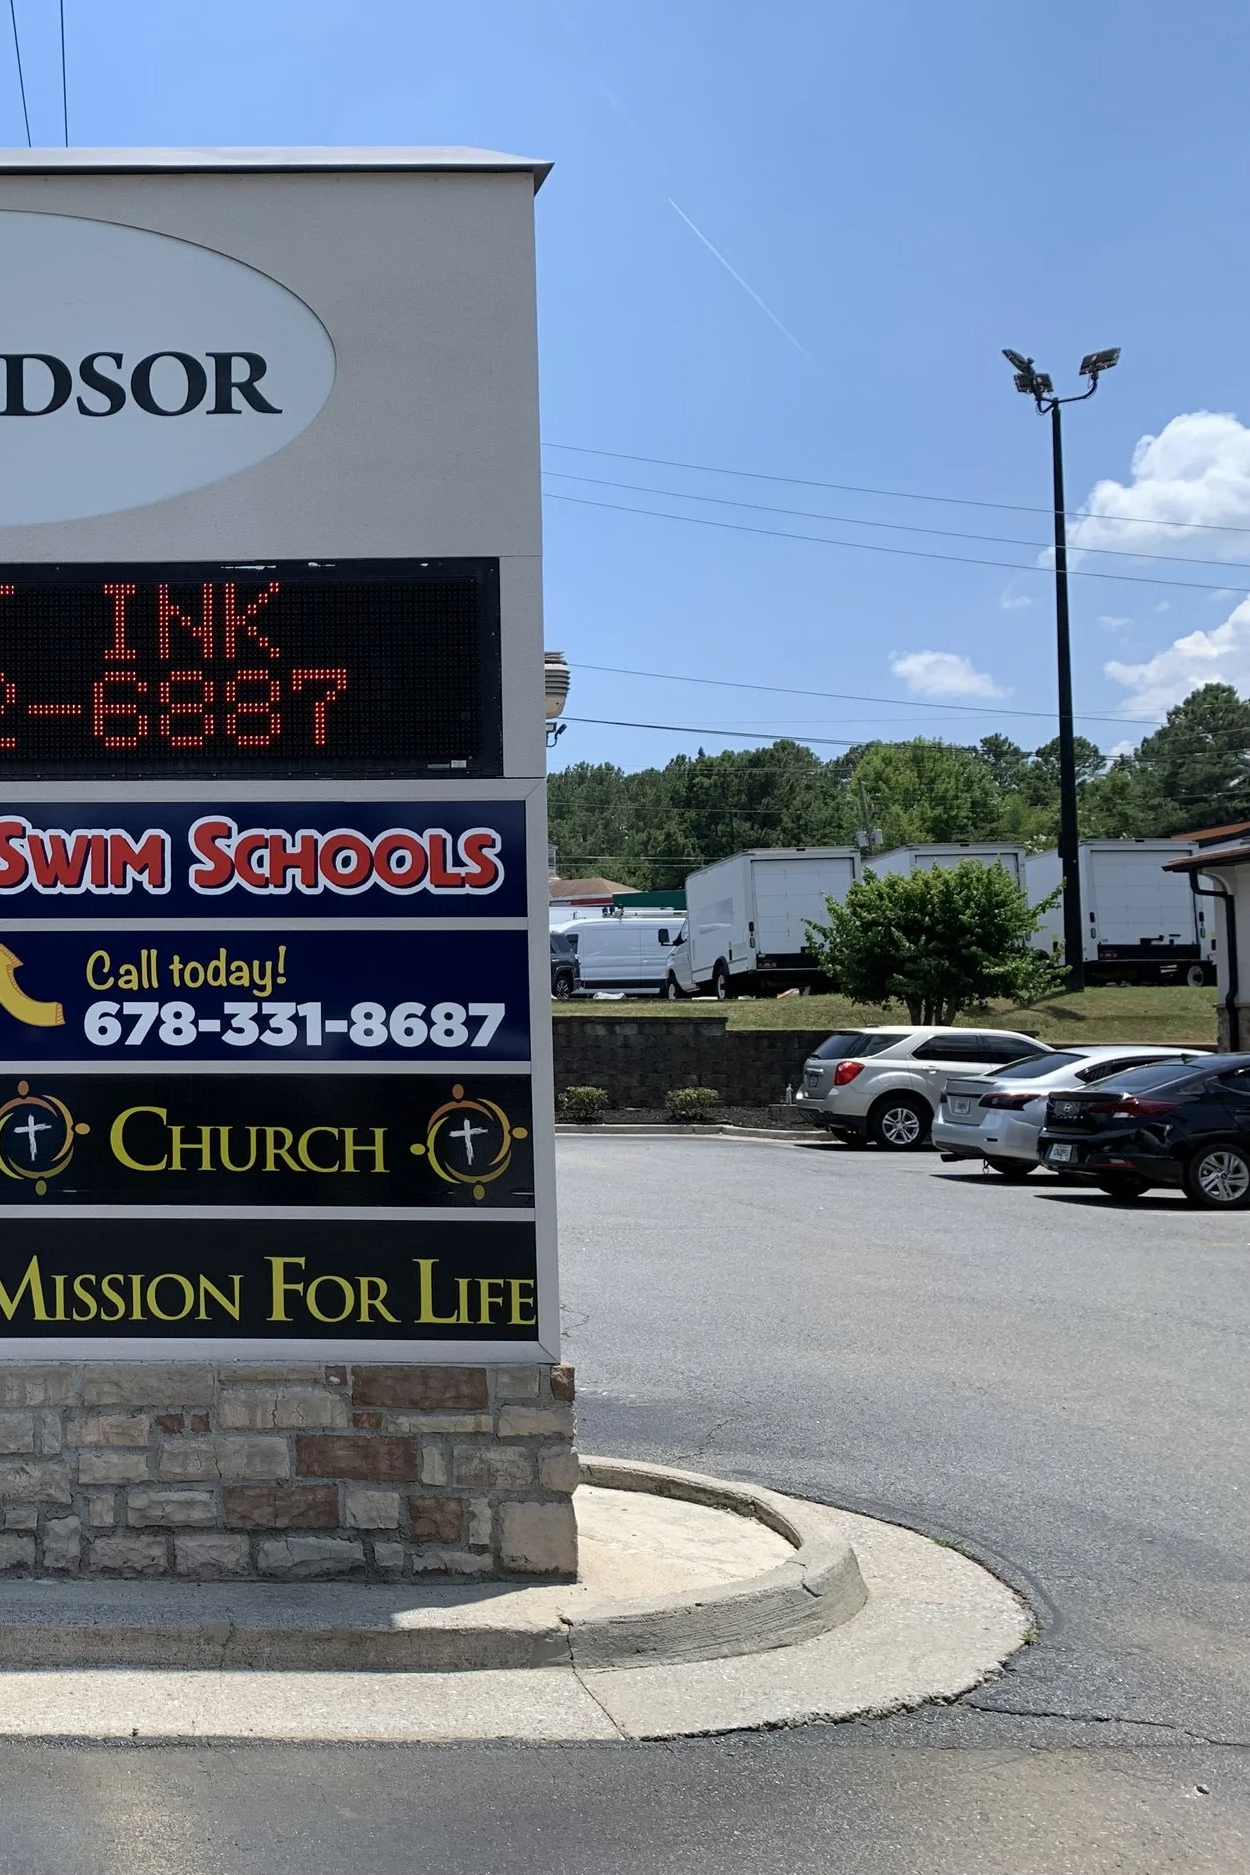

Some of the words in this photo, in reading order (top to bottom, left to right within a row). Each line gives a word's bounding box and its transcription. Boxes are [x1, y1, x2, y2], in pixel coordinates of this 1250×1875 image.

[103, 582, 280, 659] INK
[188, 815, 504, 895] SCHOOLS
[86, 949, 159, 991] Call
[169, 945, 287, 997] today!
[84, 1000, 506, 1047] 678-331-8687
[110, 1106, 390, 1173] CHURCH
[265, 1256, 401, 1323] FOR
[413, 1258, 537, 1325] LIFE
